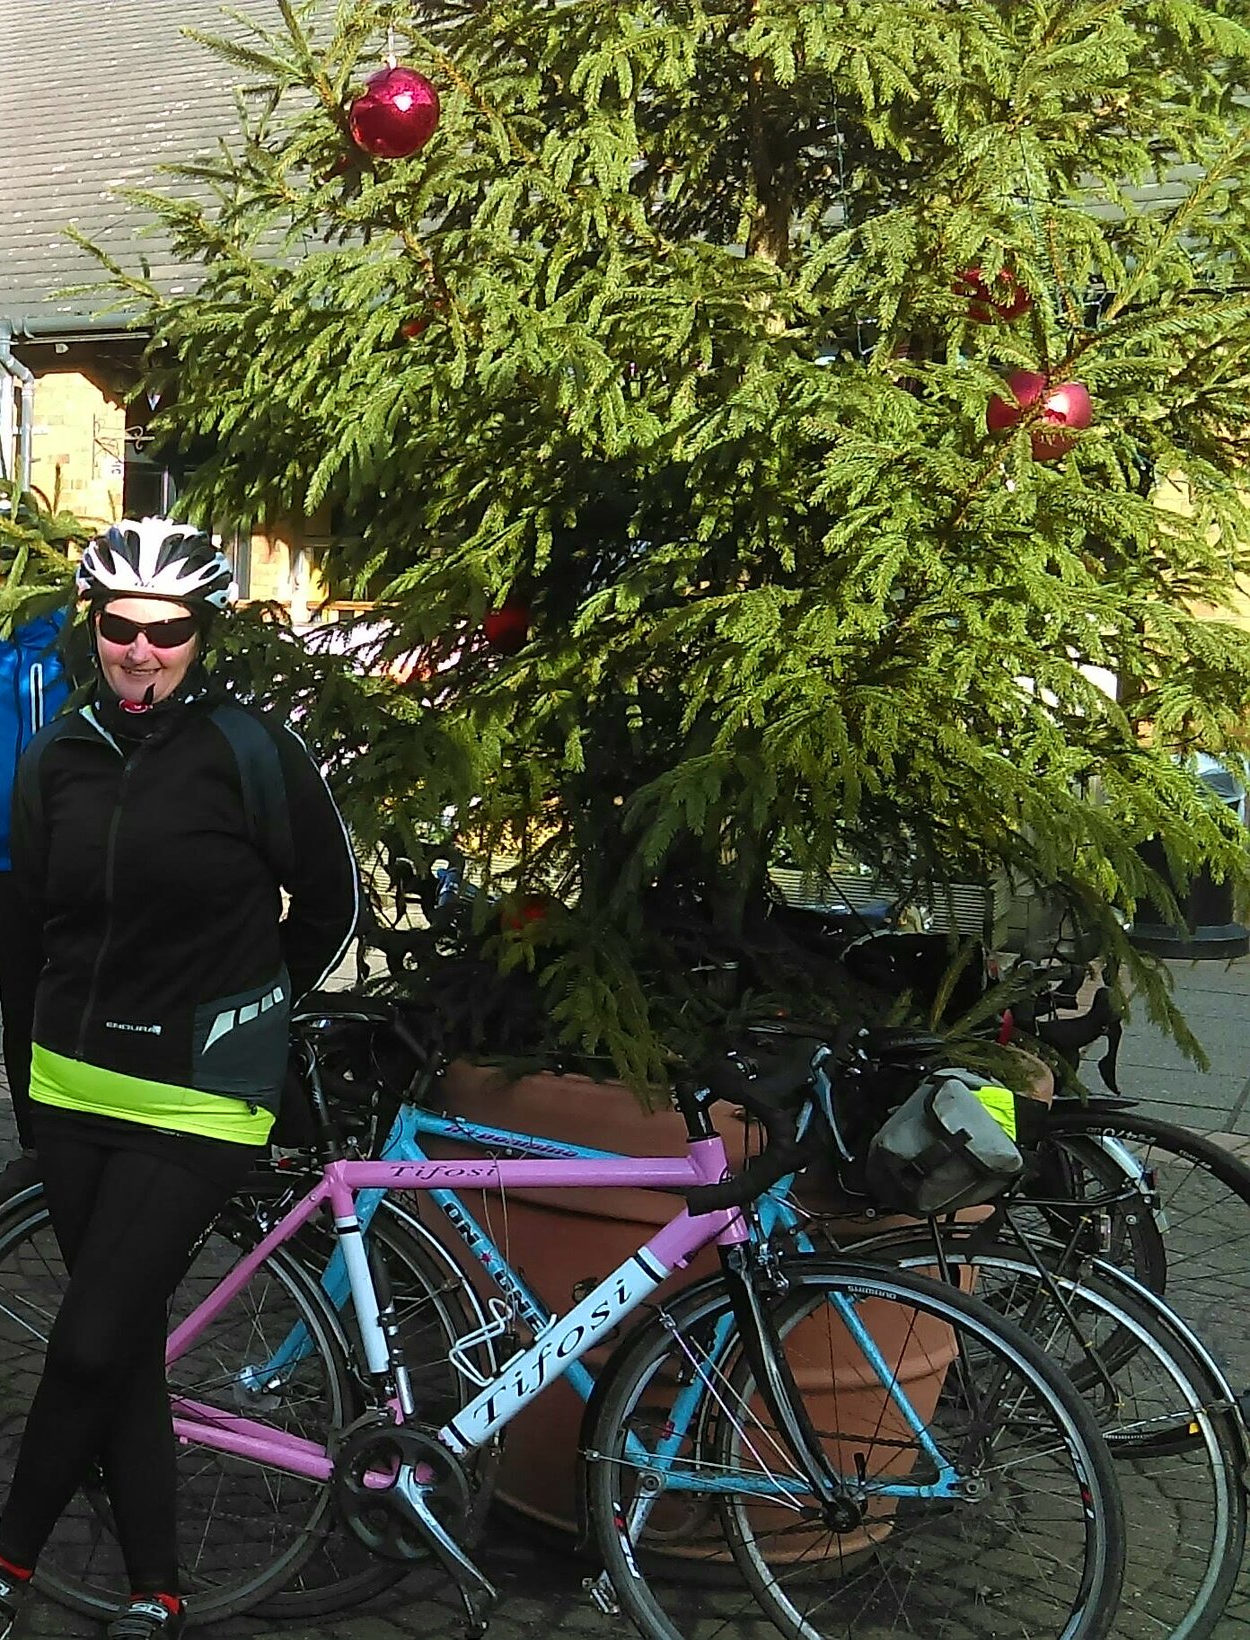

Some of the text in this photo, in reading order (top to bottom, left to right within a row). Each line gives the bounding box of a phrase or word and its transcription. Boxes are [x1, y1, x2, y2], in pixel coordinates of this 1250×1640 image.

[106, 1021, 158, 1034] ENDURA
[390, 1164, 497, 1181] Tifosi
[472, 1278, 633, 1430] Tifosi
